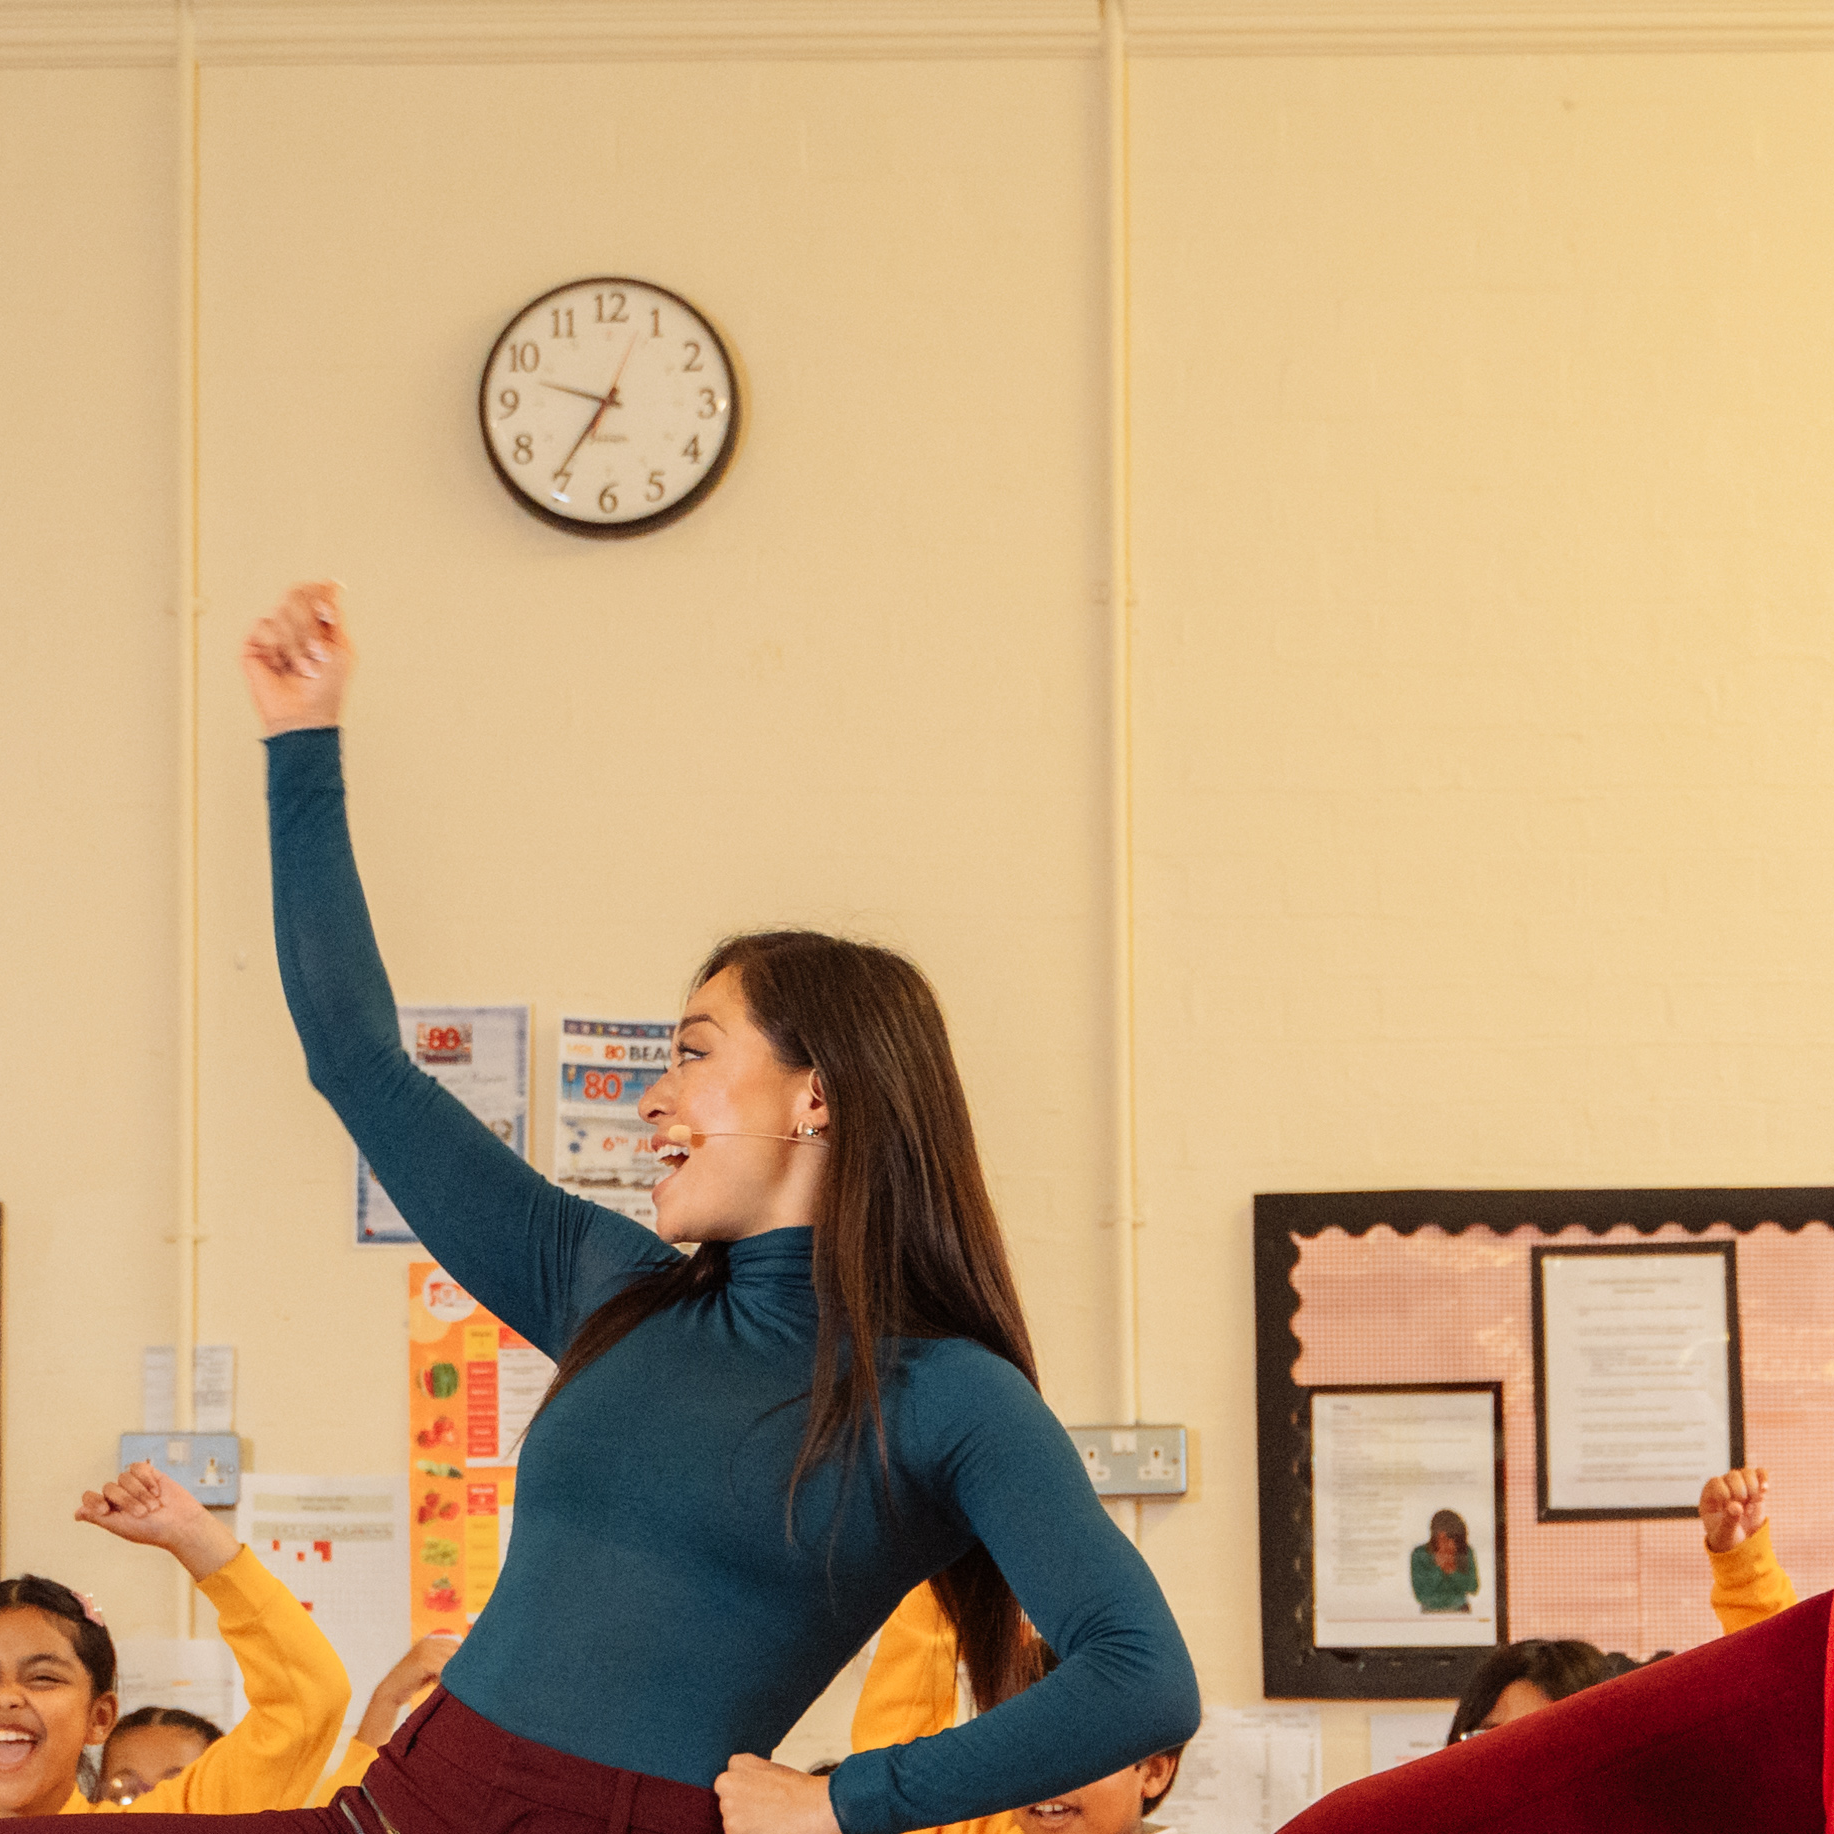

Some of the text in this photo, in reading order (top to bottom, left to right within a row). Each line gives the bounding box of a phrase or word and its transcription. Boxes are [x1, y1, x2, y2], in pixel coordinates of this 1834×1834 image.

[551, 308, 577, 339] 11
[594, 293, 629, 323] 12
[651, 308, 664, 338] 1
[508, 342, 540, 373] 10
[682, 341, 704, 372] 2
[499, 389, 520, 421] 9
[697, 388, 717, 420] 3
[513, 434, 534, 465] 8
[681, 434, 702, 464] 4
[552, 470, 572, 501] 7
[598, 483, 619, 514] 6
[646, 471, 665, 503] 5
[604, 1044, 626, 1061] 80
